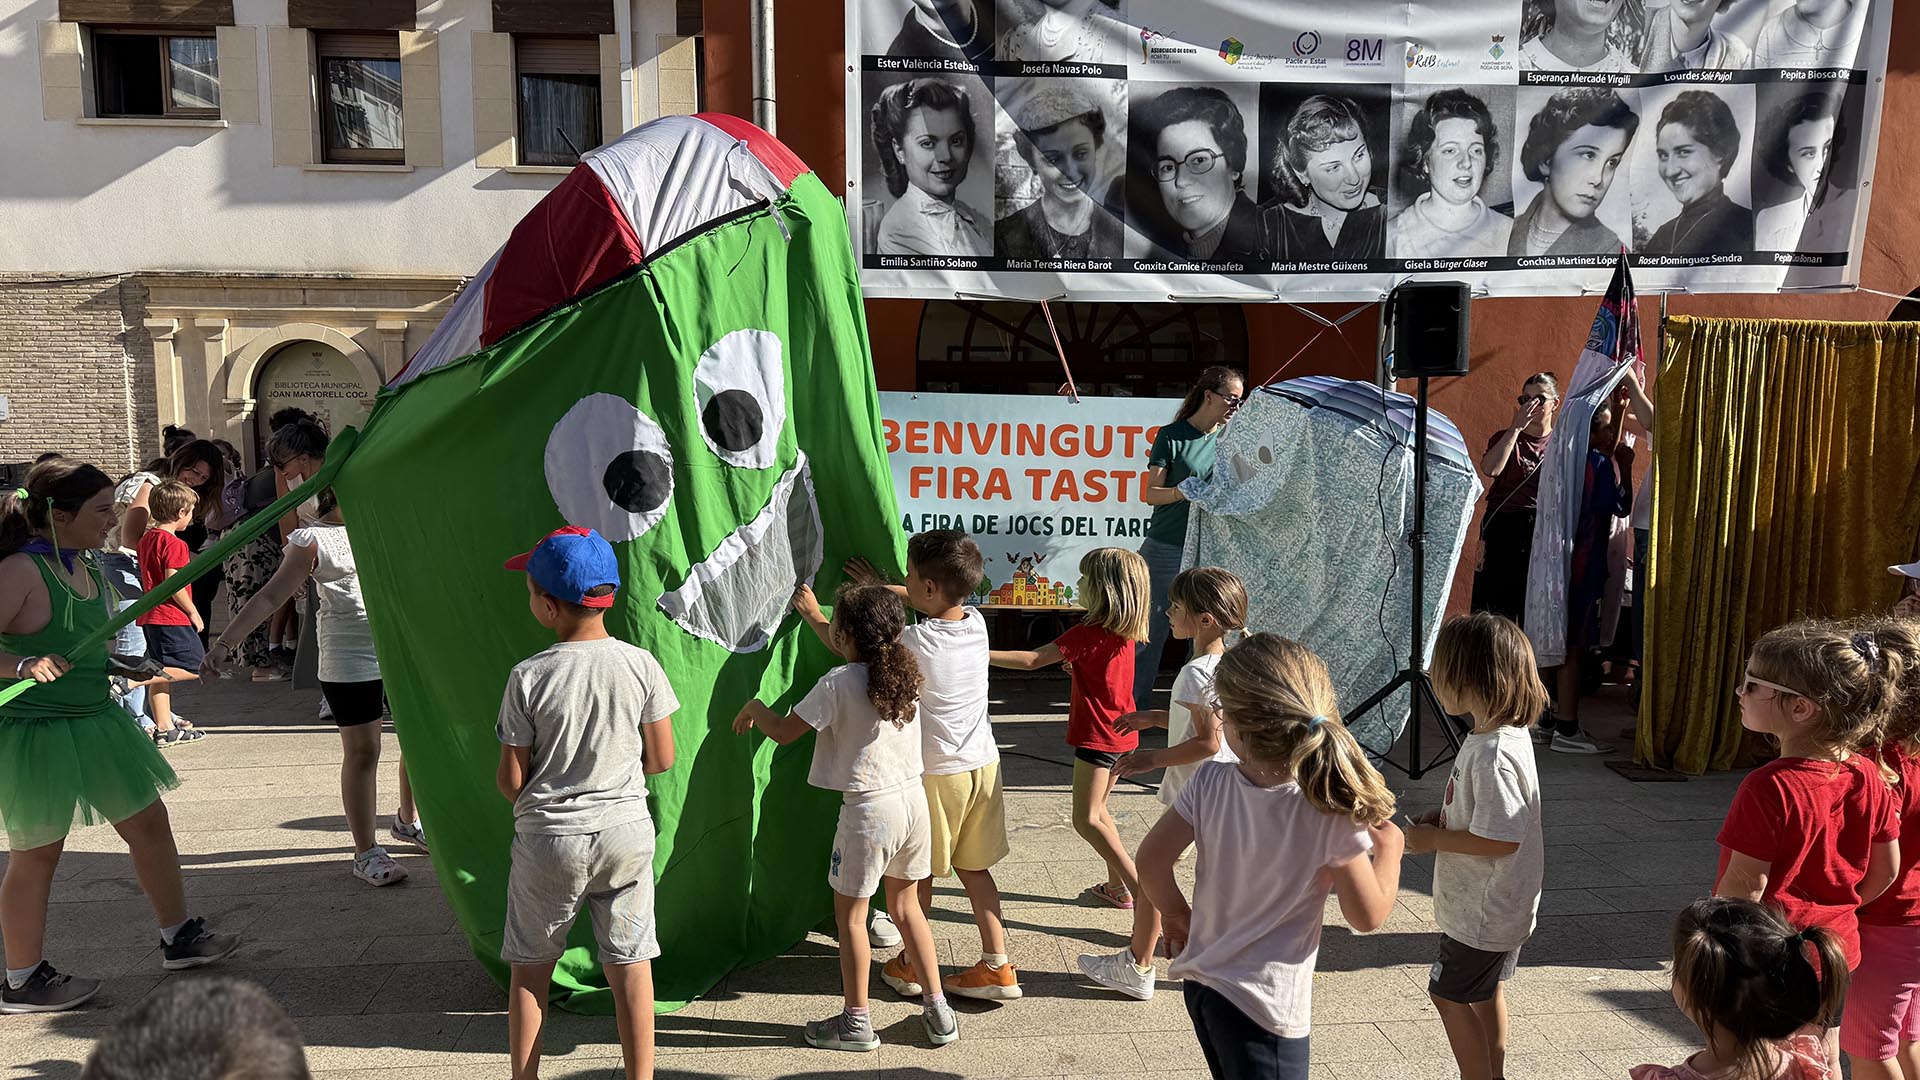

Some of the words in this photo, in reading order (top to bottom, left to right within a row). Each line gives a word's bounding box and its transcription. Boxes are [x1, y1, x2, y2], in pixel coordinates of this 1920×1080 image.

[1346, 39, 1383, 61] 8M
[877, 58, 901, 68] Ester
[902, 58, 942, 69] València
[943, 59, 980, 72] Esteban
[1021, 63, 1051, 74] Josefa
[1052, 64, 1080, 74] Navas
[1082, 65, 1103, 75] Polo
[1527, 72, 1569, 84] Esperança
[1570, 72, 1606, 84] Mercadé
[1607, 73, 1631, 86] Virgili
[1664, 71, 1700, 82] Lourdes
[1714, 71, 1733, 83] Pujol
[1780, 69, 1806, 81] Pepita
[1808, 70, 1837, 80] Biosca
[880, 257, 909, 268] Emilia
[910, 257, 945, 268] Santiño
[946, 258, 978, 268] Solano
[1006, 259, 1032, 269] Maria
[1033, 259, 1062, 270] Teresa
[1063, 260, 1087, 270] Riera
[1088, 260, 1112, 270] Barot
[1133, 261, 1167, 271] Conxita
[1201, 261, 1244, 272] Prenafeta
[1271, 262, 1297, 272] Maria
[1298, 261, 1330, 271] Mestre
[1331, 260, 1368, 271] Güixens
[1404, 260, 1432, 270] Gisela
[1433, 259, 1462, 272] Bürger
[1462, 258, 1488, 268] Glaser
[1517, 256, 1556, 267] Conchita
[1557, 255, 1595, 266] Martínez
[1638, 256, 1659, 266] Roser
[1660, 254, 1711, 267] Domínguez
[1711, 254, 1743, 264] Sendra
[274, 382, 320, 390] BIBLIOTECA
[909, 466, 1012, 501] FIRA
[921, 513, 965, 534] FIRA
[972, 515, 999, 535] DE
[1006, 515, 1054, 536] JOCS
[1061, 516, 1098, 537] DEL
